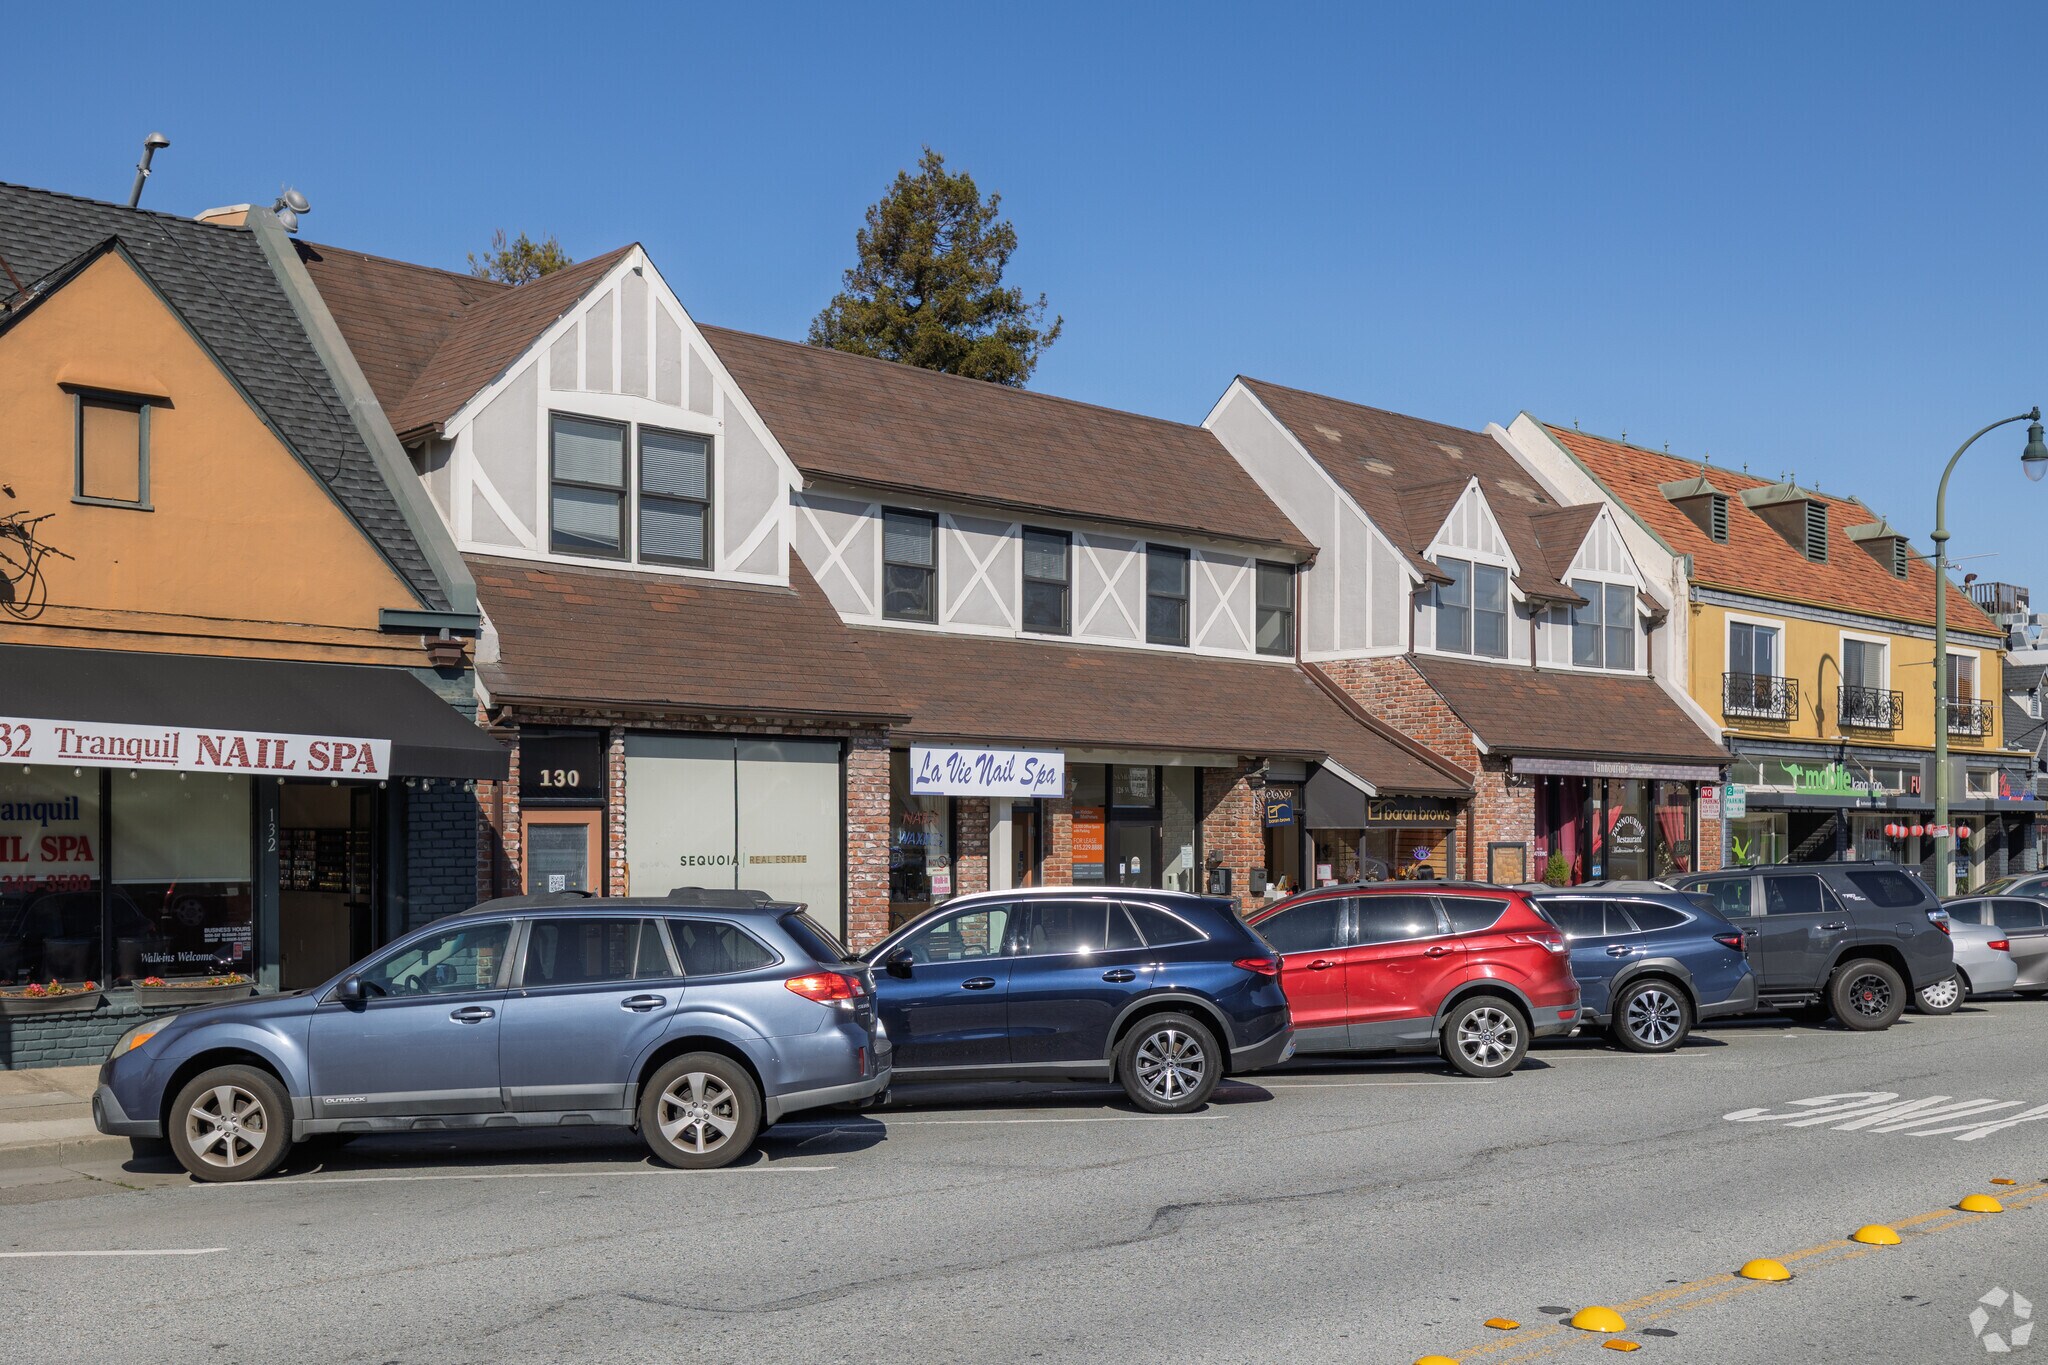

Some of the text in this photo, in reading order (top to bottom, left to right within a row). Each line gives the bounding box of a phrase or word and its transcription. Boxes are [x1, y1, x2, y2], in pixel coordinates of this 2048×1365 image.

[54, 727, 181, 764] Tranquil
[194, 734, 297, 770] NAIL
[307, 740, 378, 774] SPA
[916, 750, 1056, 791] La Vie Nail Spa
[1593, 760, 1629, 774] Tannourine
[1805, 763, 1851, 791] mobile
[540, 769, 580, 788] 130
[1, 796, 80, 827] anquil
[1385, 801, 1451, 821] baran brows
[268, 808, 276, 852] 132
[1611, 815, 1646, 838] TANNOURINE
[40, 836, 95, 863] SPA
[1616, 836, 1642, 844] Restaurant
[680, 855, 807, 867] SEQUOIA REAL ESTATE
[141, 951, 214, 963] Walk-ins Welcome
[325, 1096, 367, 1104] OUTBACK
